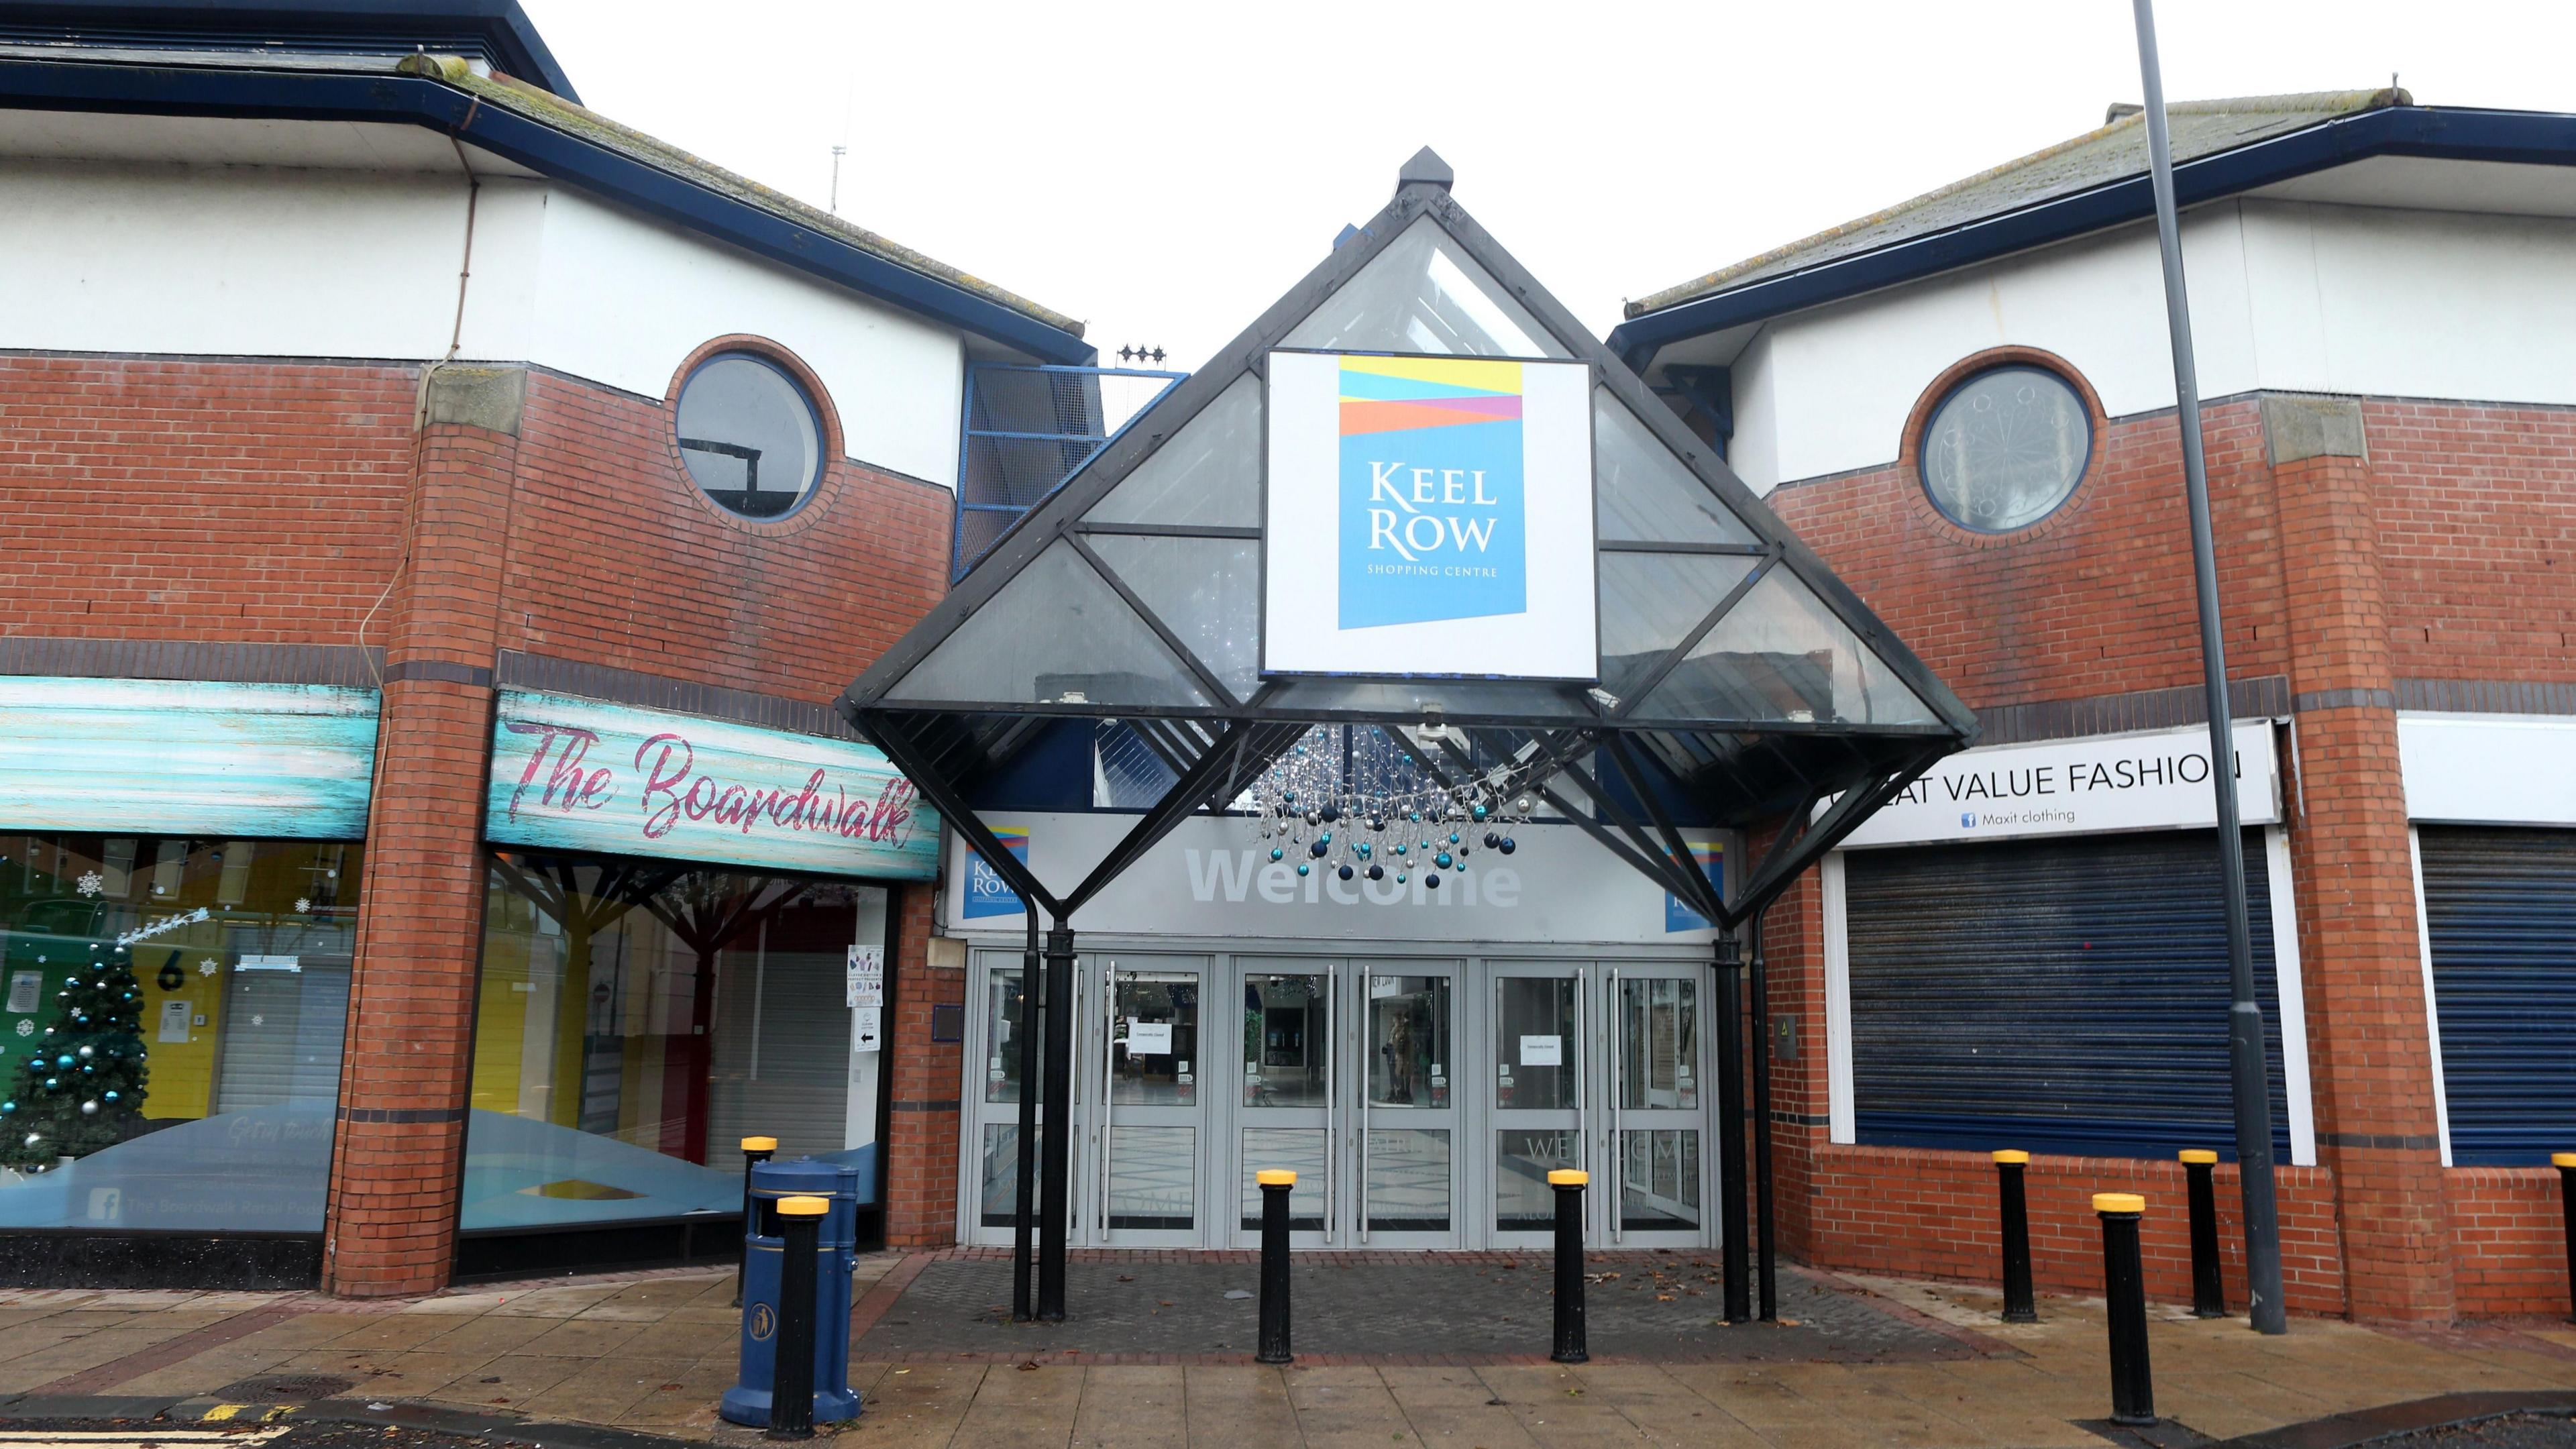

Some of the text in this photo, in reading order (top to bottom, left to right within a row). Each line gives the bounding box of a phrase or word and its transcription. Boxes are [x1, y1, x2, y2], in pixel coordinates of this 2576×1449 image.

[1366, 461, 1497, 514] KEEL
[1366, 508, 1498, 561] ROW
[1367, 564, 1497, 578] SHOPPING CENTRE
[504, 721, 916, 849] The Boardwalk
[1943, 766, 2055, 801] VALUE
[1982, 808, 2076, 826] Maxit clothing
[1184, 847, 1522, 907] Welcome
[157, 949, 184, 991] 6
